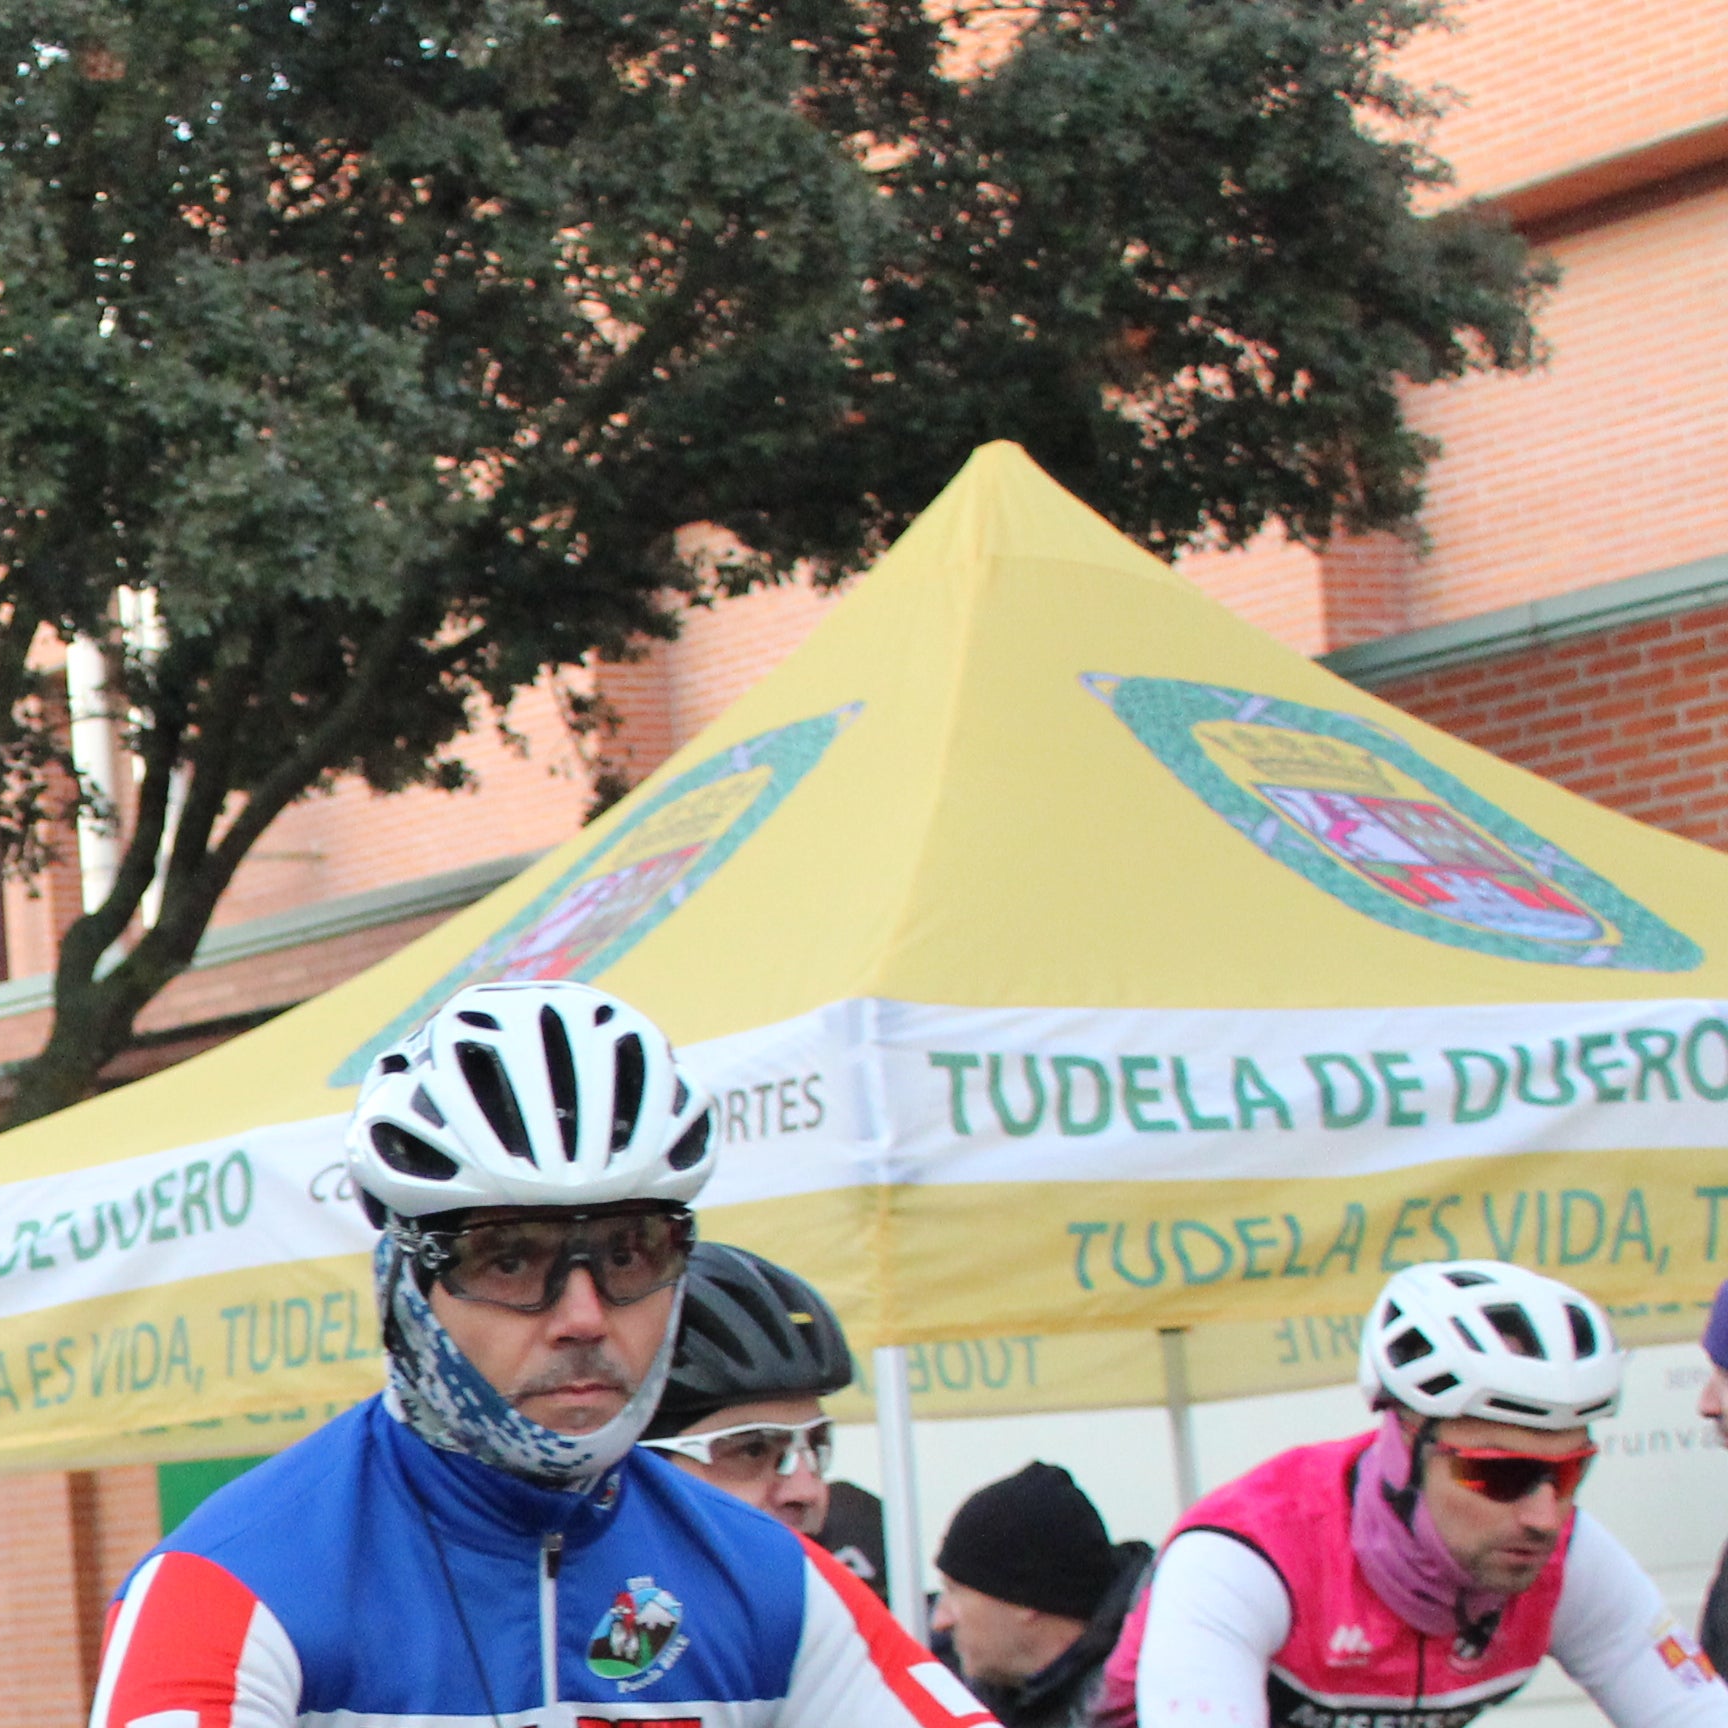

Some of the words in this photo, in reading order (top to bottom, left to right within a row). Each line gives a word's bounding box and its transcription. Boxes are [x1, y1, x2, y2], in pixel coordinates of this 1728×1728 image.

[928, 1051, 1294, 1137] TUDELA
[1303, 1051, 1426, 1130] DE
[1443, 1017, 1728, 1125] DUERO
[1066, 1200, 1368, 1291] TUDELA
[1379, 1193, 1463, 1266] ES
[1480, 1187, 1672, 1274] VIDA,
[25, 1336, 77, 1410] ES
[89, 1315, 206, 1397] VIDA,
[219, 1290, 385, 1378] TUDEL
